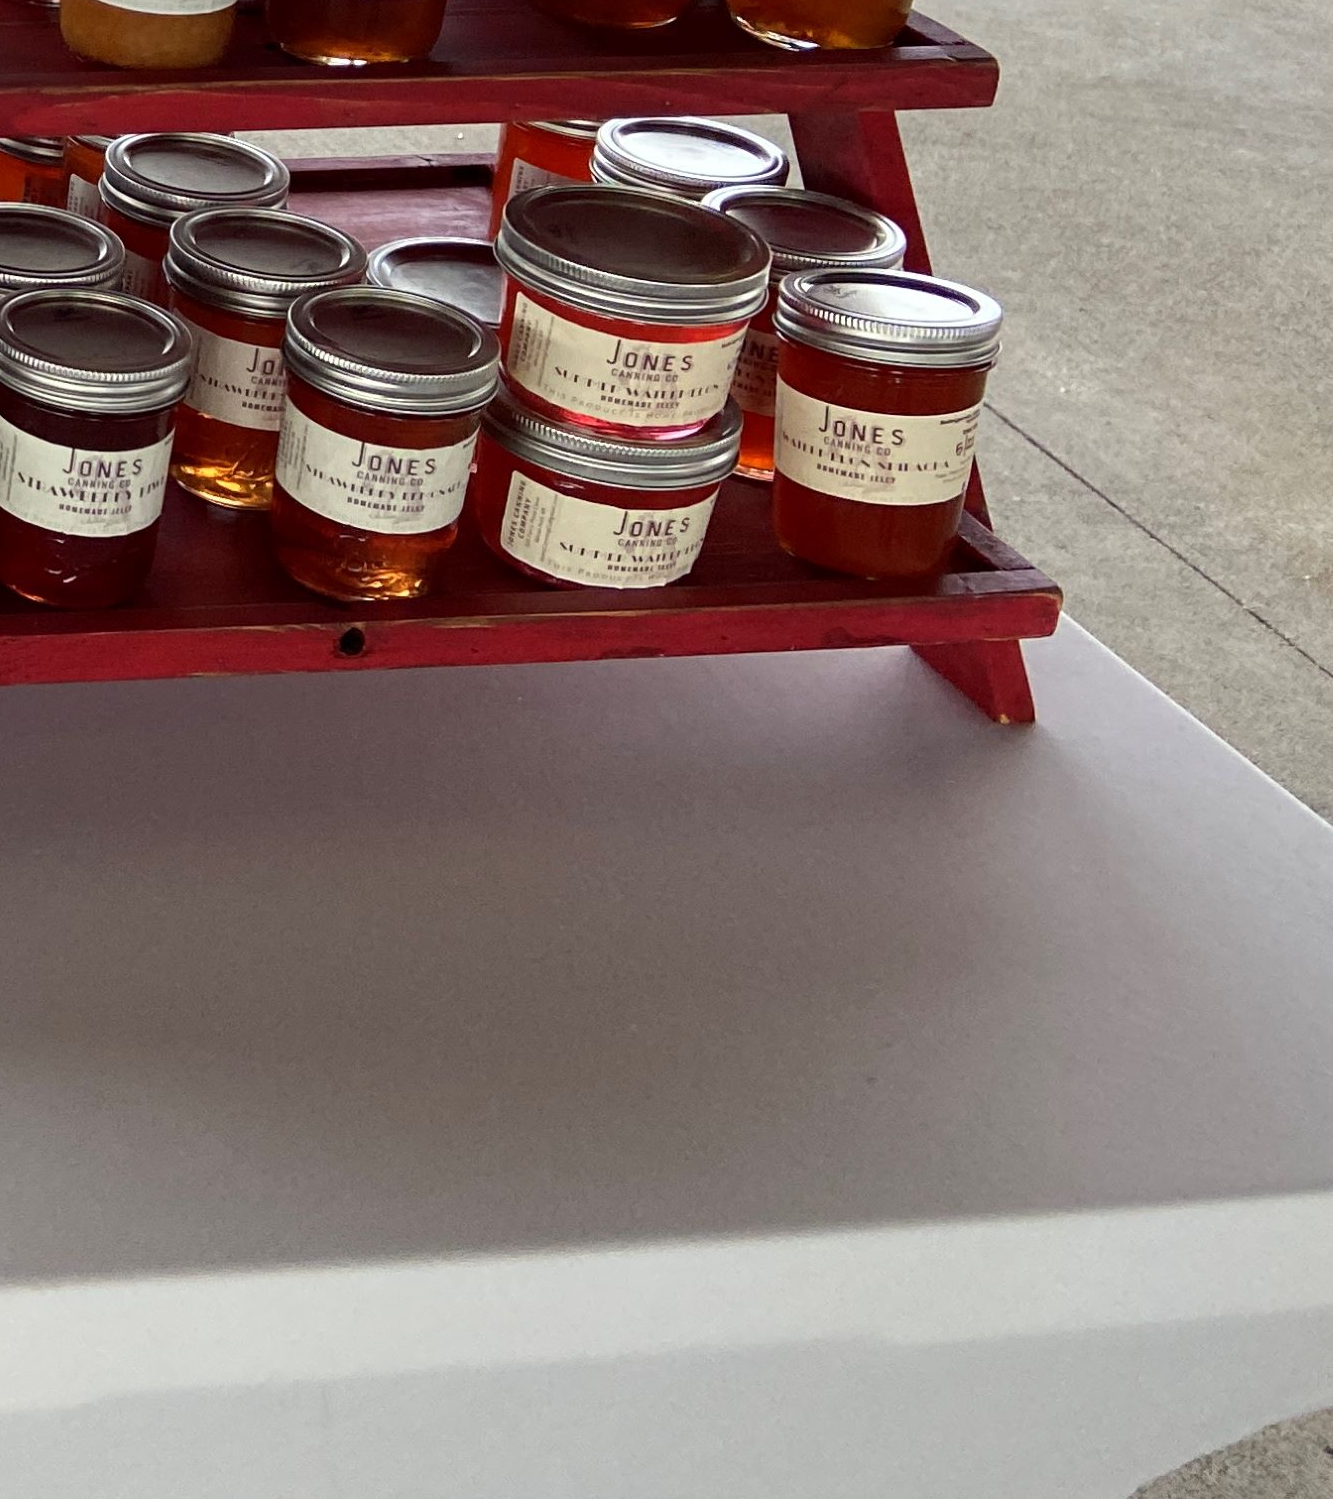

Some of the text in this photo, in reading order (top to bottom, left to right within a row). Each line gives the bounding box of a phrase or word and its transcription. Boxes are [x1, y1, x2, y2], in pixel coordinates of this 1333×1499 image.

[606, 339, 693, 372] JONES
[818, 405, 905, 446] JONES
[62, 448, 143, 479] JONES
[352, 442, 437, 476] JONES
[18, 471, 133, 503] STRAWBERRY
[613, 511, 691, 538] JONES
